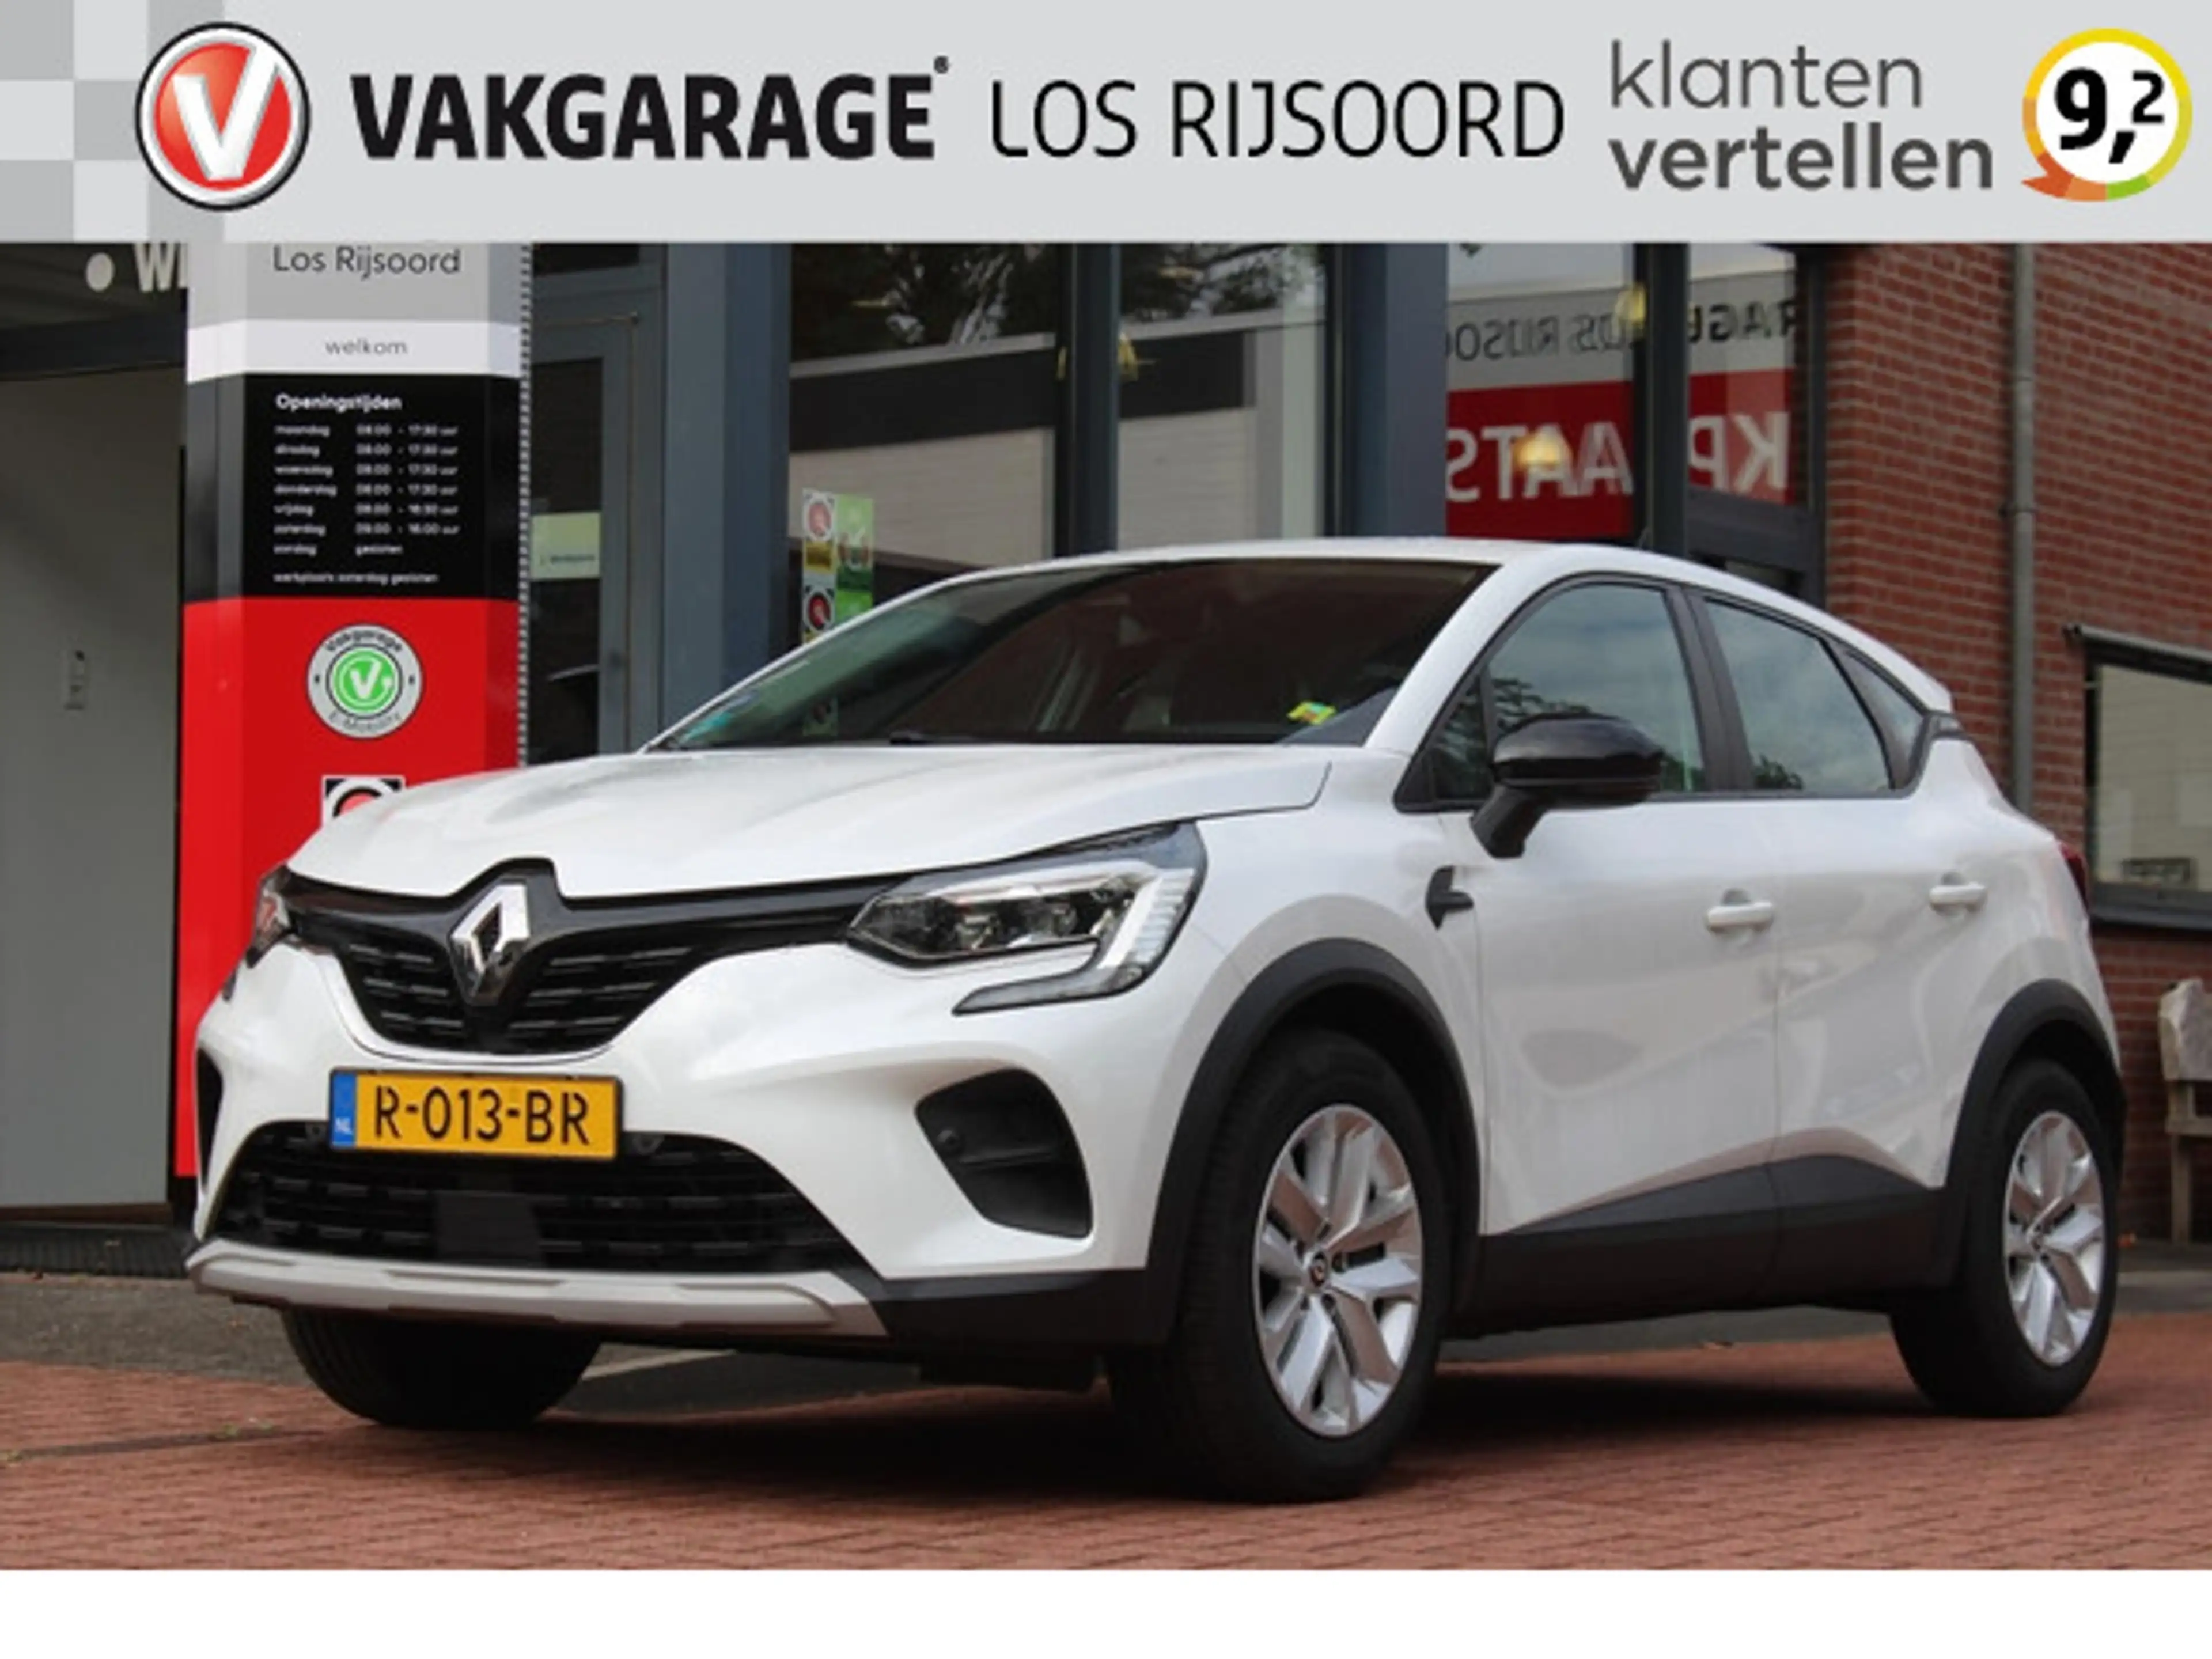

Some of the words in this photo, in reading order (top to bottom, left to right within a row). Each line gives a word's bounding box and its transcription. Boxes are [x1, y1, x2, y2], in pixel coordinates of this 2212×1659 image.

[273, 245, 327, 273] Los
[335, 245, 461, 281] Rijsoord
[325, 339, 407, 355] welkom
[275, 393, 402, 412] Openingstijden
[375, 1085, 590, 1145] R-013-BR
